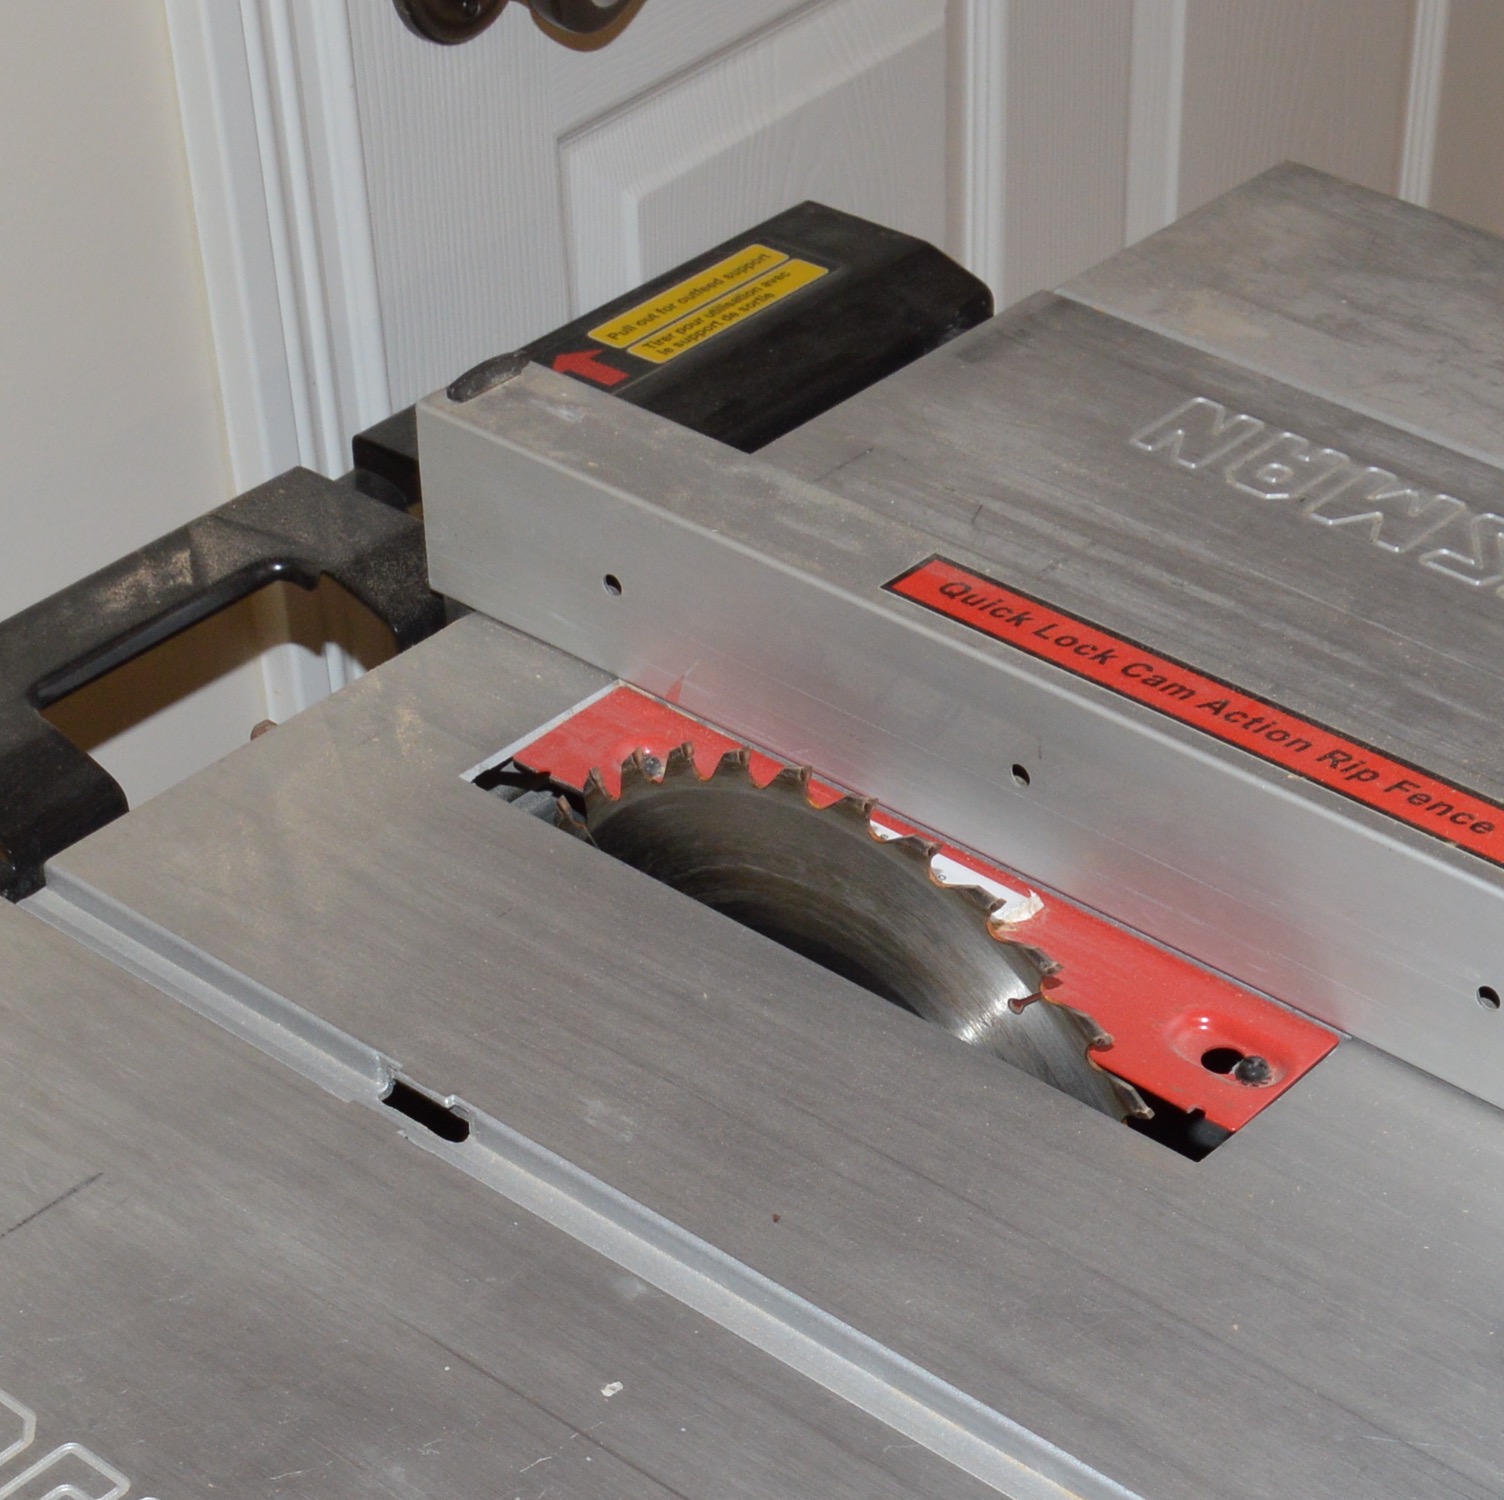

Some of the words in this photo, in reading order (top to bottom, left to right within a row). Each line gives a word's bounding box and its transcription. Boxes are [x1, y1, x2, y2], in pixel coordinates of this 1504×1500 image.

[607, 322, 636, 341] Pull
[636, 311, 659, 327] out
[658, 301, 678, 316] for
[677, 277, 724, 304] outfeed
[723, 253, 772, 281] support
[643, 331, 676, 350] Tirer
[675, 315, 705, 336] pour
[704, 285, 763, 319] utilisation
[761, 270, 792, 288] avec
[657, 344, 676, 356] le
[675, 319, 724, 350] support
[722, 310, 739, 322] de
[738, 292, 776, 315] sortie
[937, 578, 1030, 631] Quick
[1031, 621, 1118, 667] Lock
[1119, 660, 1197, 702] Cam
[1195, 697, 1314, 754] Action
[1314, 748, 1382, 786] Rip
[1383, 779, 1497, 837] Fence
